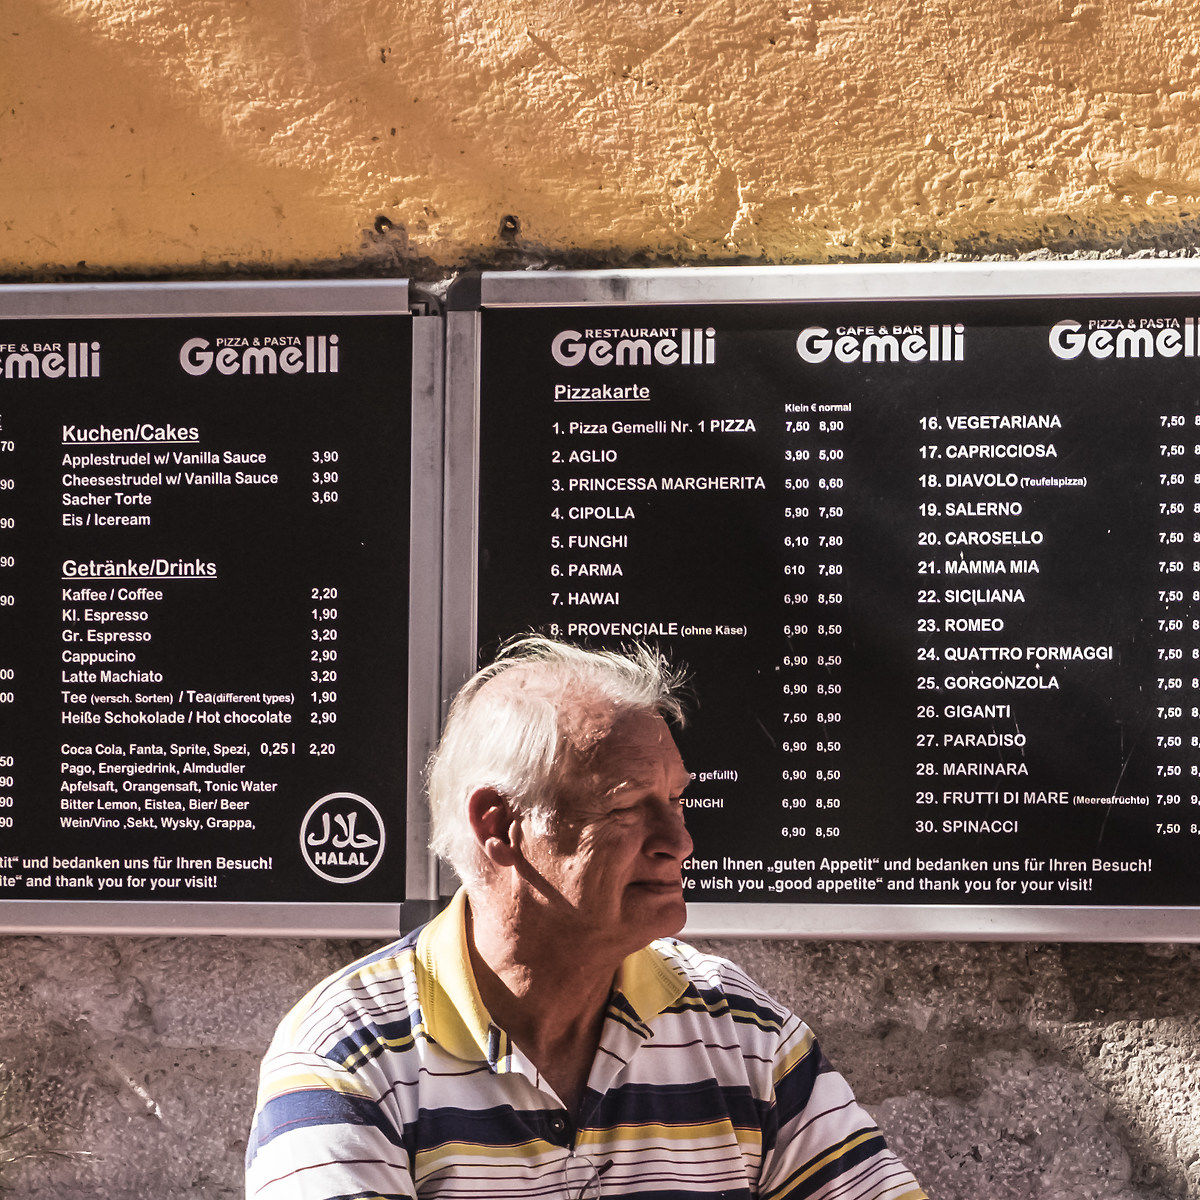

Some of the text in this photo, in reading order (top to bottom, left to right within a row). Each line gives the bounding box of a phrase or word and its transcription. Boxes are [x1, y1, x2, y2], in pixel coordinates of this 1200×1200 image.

[836, 325, 924, 336] CAFE BAR
[1088, 318, 1180, 330] PIZZA PASTA
[585, 328, 678, 338] RESTAURANT
[33, 343, 62, 352] BAR
[217, 337, 301, 346] PIZZA PASTA
[551, 327, 716, 367] Gemelli
[796, 323, 965, 364] Gemelli
[179, 334, 340, 376] Gemelli
[555, 384, 649, 399] Pizzakarte
[785, 404, 808, 412] Klein
[819, 403, 851, 412] normal
[570, 419, 756, 434] Pizza Gemelli Nr. PIZZA
[946, 415, 1061, 429] VEGETARIANA
[63, 424, 199, 441] Kuchen/Cakes
[312, 451, 338, 463] 3,90
[569, 450, 617, 462] AGLIO
[946, 444, 1057, 458] CAPRICCIOSA
[62, 451, 266, 467] Applestrudel w/ Vanilla Sauce
[63, 472, 278, 486] Cheesestrudel w/ Vanilla Sauce
[313, 472, 338, 484] 3,90
[570, 477, 765, 491] PRINCESSA MARGHERITA
[946, 474, 1018, 487] DIAVOLO
[63, 493, 151, 505] Sacher Torte
[312, 491, 338, 504] 3,60
[569, 507, 635, 519] CIPOLLA
[946, 502, 1022, 516] SALERNO
[63, 514, 83, 526] Eis
[569, 535, 627, 548] FUNGHI
[945, 531, 1043, 546] CAROSELLO
[63, 559, 216, 576] Getränke/Drinks
[569, 564, 623, 576] PARMA
[784, 565, 842, 576] 610 7,80
[945, 560, 1039, 574] MAMMA MIA
[63, 588, 163, 601] Kaffee Coffee
[312, 588, 337, 600] 2,20
[569, 593, 619, 605] HAWAI
[945, 589, 1025, 604] SICILIANA
[63, 609, 148, 624] Kl. Espresso
[312, 609, 337, 621] 1,90
[569, 623, 678, 636] PROVENCIALE
[945, 619, 1004, 631] ROMEO
[62, 630, 151, 644] Gr. Espresso
[311, 629, 337, 641] 3,20
[62, 650, 135, 665] Cappucino
[311, 650, 337, 662] 2,90
[945, 646, 1112, 661] QUATTRO FORMAGGI
[62, 670, 163, 682] Latte Machiato
[311, 671, 337, 683] 3,20
[945, 676, 1059, 689] GORGONZOLA
[61, 691, 87, 703] Tee
[311, 692, 336, 704] 1,90
[62, 711, 291, 724] Heiße Schokolade Hot chocolate
[311, 712, 336, 724] 2,90
[944, 705, 1010, 718] GIGANTI
[944, 734, 1026, 746] PARADISO
[61, 743, 288, 756] Coca Cola, Fanta, Sprite, Spezi, 0,25
[310, 744, 335, 756] 2,20
[61, 763, 245, 776] Pago, Energiedrink, Almdudler
[944, 763, 1028, 775] MARINARA
[61, 781, 277, 794] Apfelsaft, Orangensaft, Tonic Water
[944, 792, 1068, 804] FRUTTI DI MARE
[61, 799, 249, 811] Bitter Lemon, Eistea, Bier/ Beer
[60, 817, 120, 827] Wein/Vino
[161, 817, 203, 830] Wysky,
[207, 817, 255, 830] Grappa,
[943, 821, 1017, 832] SPINACCI
[314, 852, 370, 867] HALAL
[723, 857, 763, 870] Ihnen
[884, 858, 911, 870] und
[917, 858, 987, 871] bedanken
[993, 861, 1019, 871] uns
[1025, 858, 1045, 871] für
[1050, 859, 1086, 871] Ihren
[1093, 859, 1151, 871] Besuch!
[701, 877, 733, 889] wish
[738, 880, 763, 892] you
[887, 878, 914, 890] and
[919, 878, 959, 890] thank
[965, 881, 991, 893] you
[996, 878, 1016, 890] for
[1021, 881, 1054, 893] your
[1058, 879, 1092, 890] visit!
